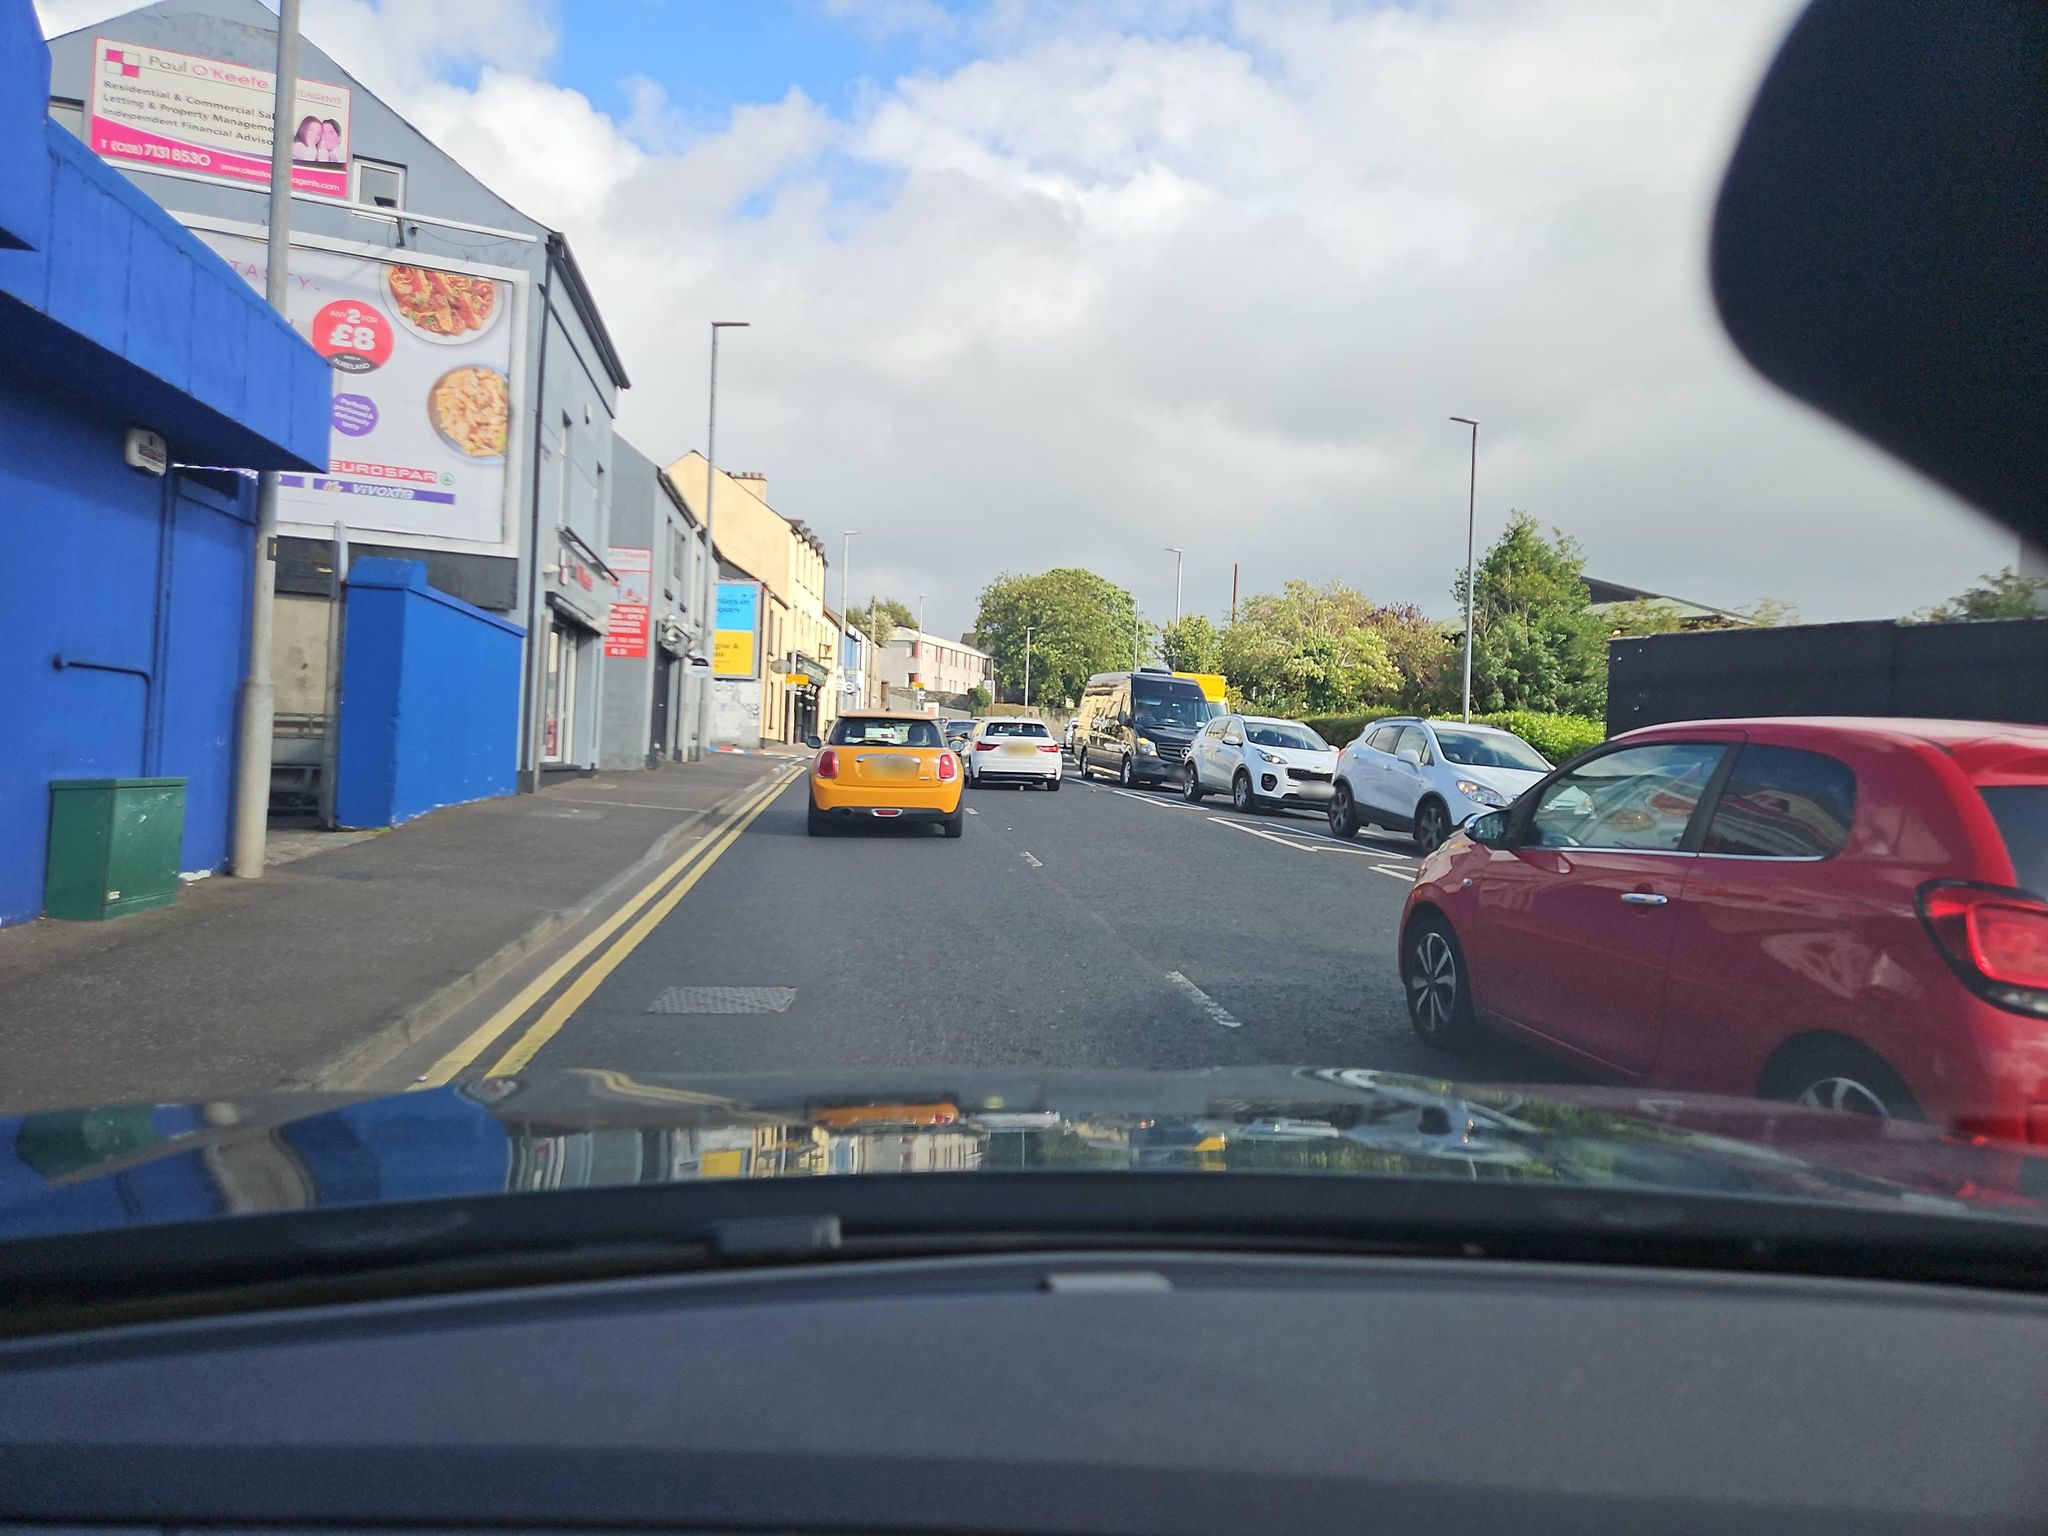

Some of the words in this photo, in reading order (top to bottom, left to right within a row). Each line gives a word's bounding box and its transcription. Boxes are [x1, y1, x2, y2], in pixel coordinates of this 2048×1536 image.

[149, 56, 187, 73] Paul
[191, 64, 270, 89] O'Keefe
[103, 80, 171, 100] Residential
[186, 96, 255, 116] Commercial
[103, 93, 144, 110] Letting
[149, 102, 156, 110] &
[160, 101, 209, 121] Property
[213, 114, 274, 133] Manageme
[103, 107, 178, 129] Independent
[182, 121, 233, 138] Financial
[236, 132, 273, 146] Adviso
[110, 140, 143, 156] (028)
[144, 143, 170, 159] 7131
[329, 310, 347, 318] ANY
[346, 308, 361, 324] 2
[361, 315, 378, 323] FOR
[329, 323, 376, 351] £8
[330, 460, 437, 482] EUROSPAR
